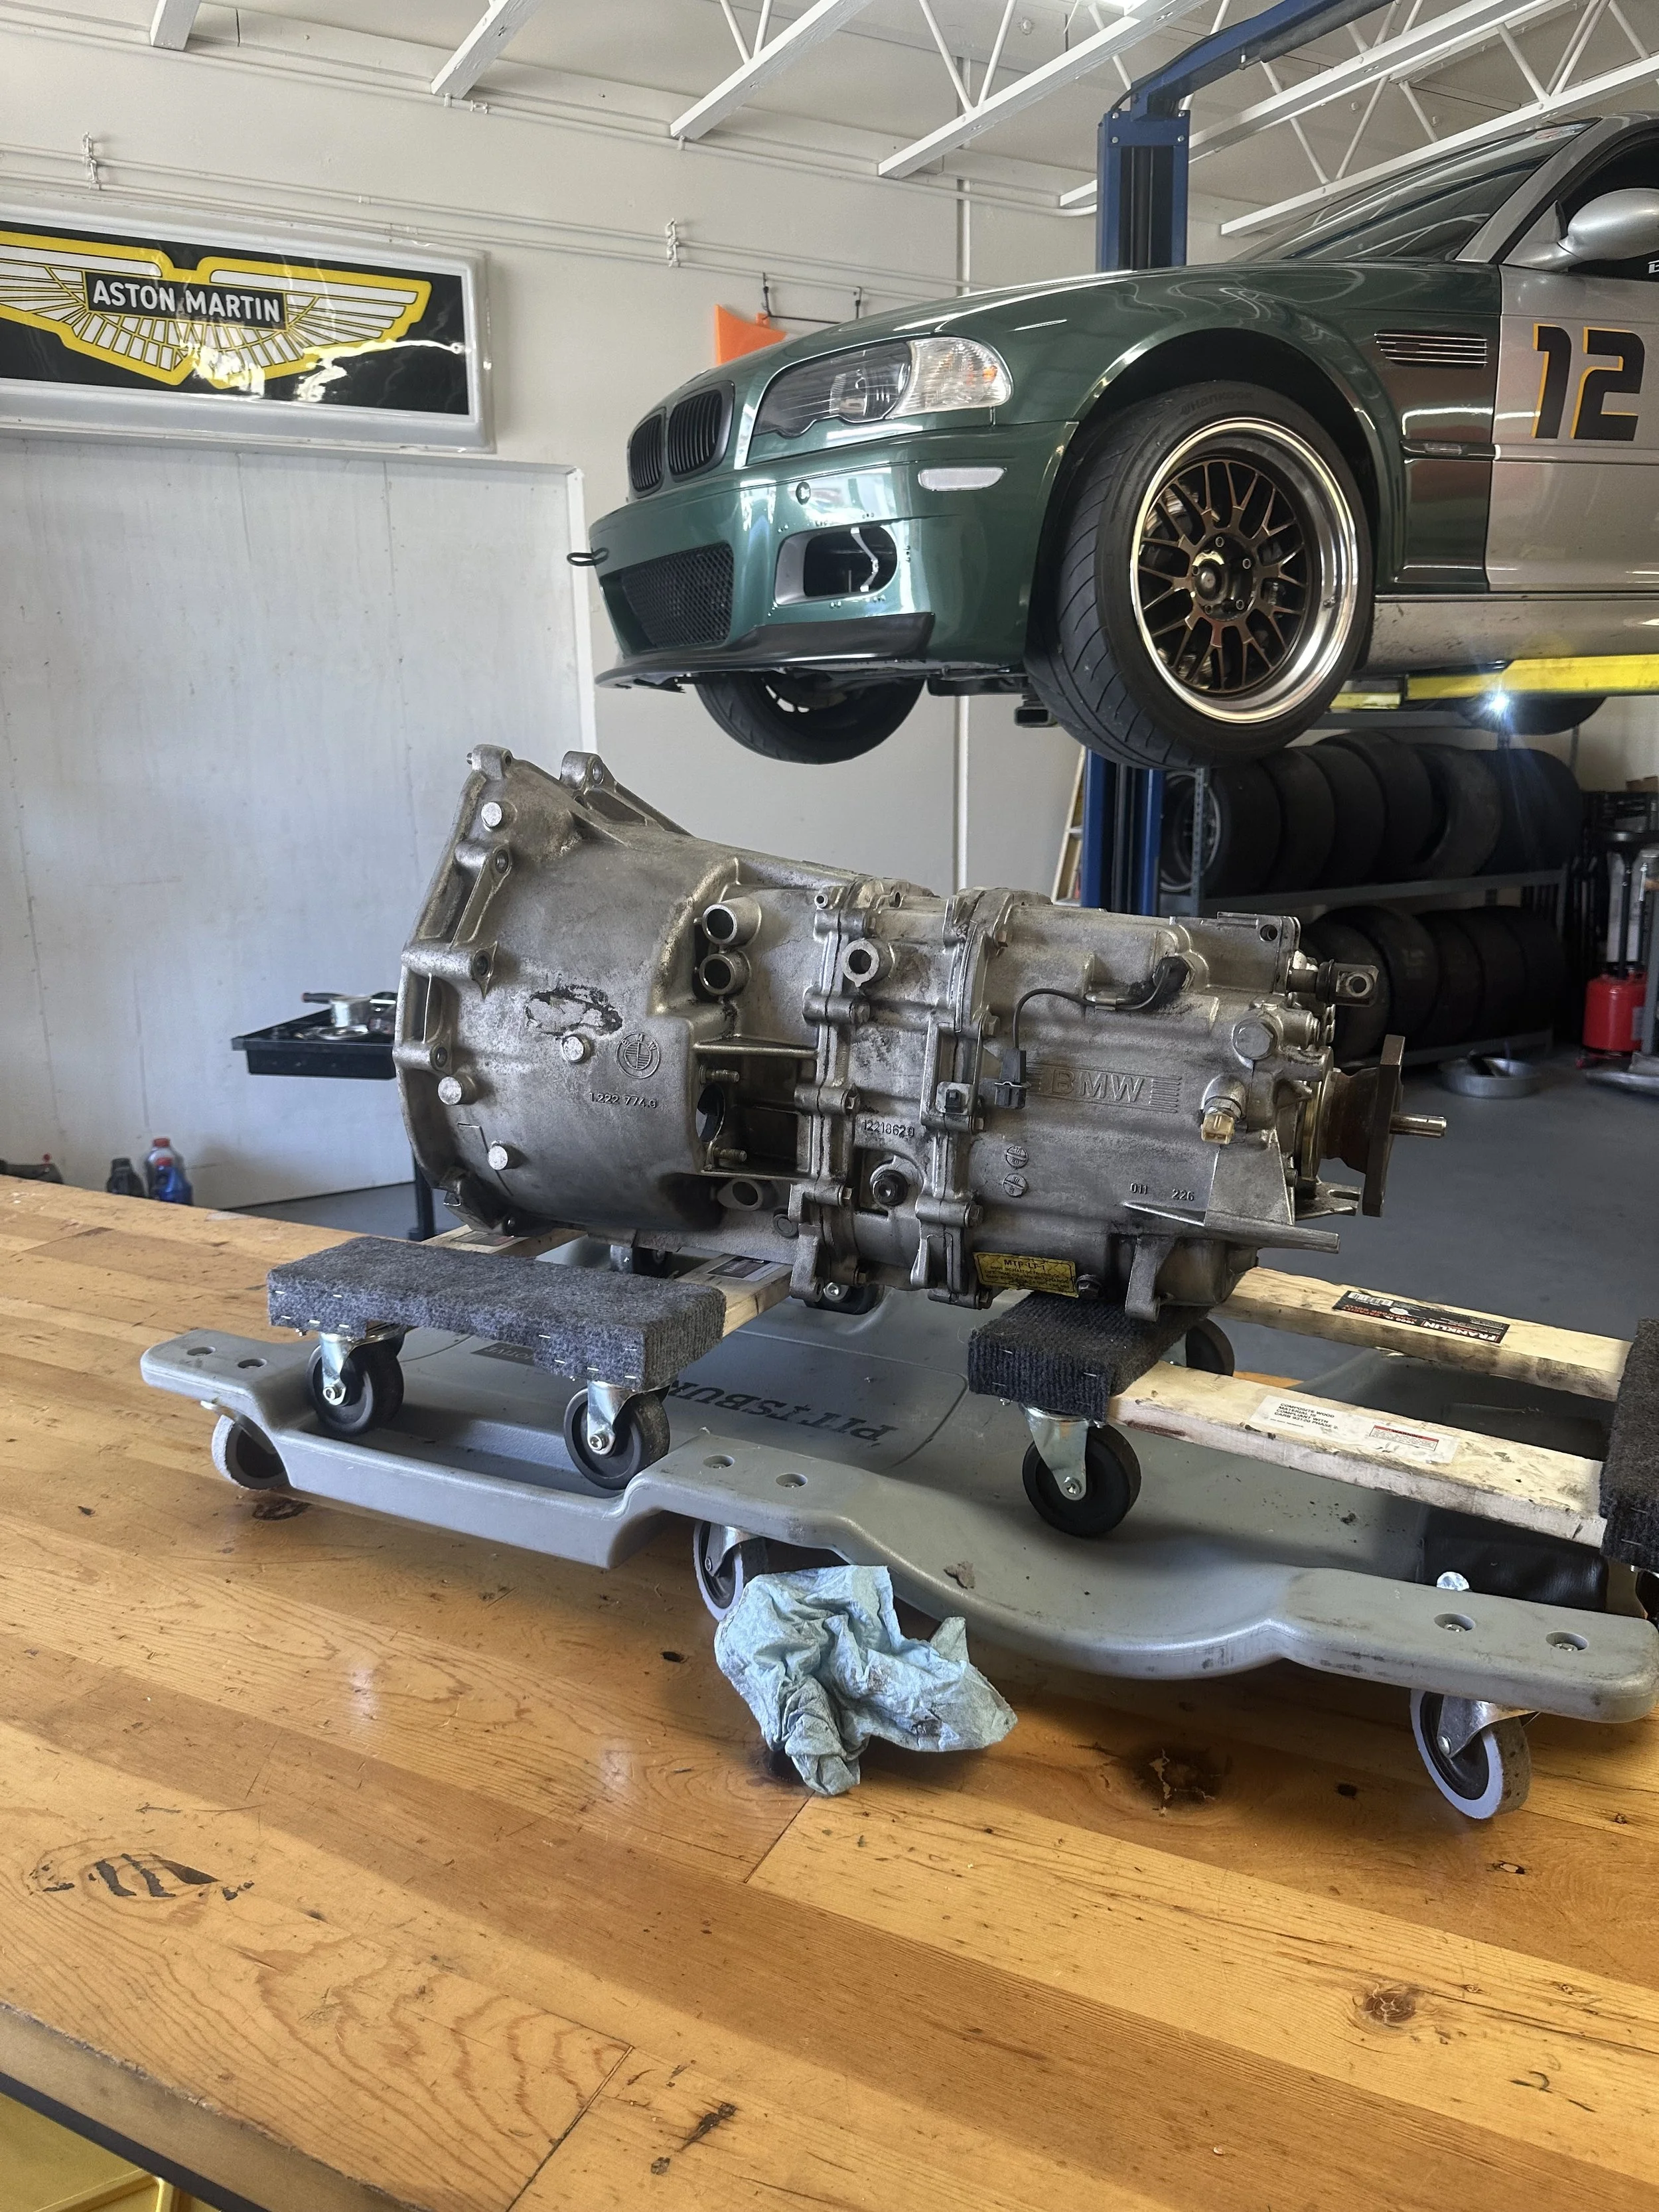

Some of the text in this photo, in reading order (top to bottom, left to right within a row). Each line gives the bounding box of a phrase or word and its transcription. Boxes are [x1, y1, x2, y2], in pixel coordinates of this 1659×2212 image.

[93, 279, 280, 323] ASTON MARTIN
[1531, 323, 1645, 441] 12
[1052, 1069, 1145, 1103] BMW
[1172, 1188, 1194, 1201] 226
[1423, 1321, 1497, 1341] FRANKLIN
[1276, 1409, 1311, 1419] COMPLIANT
[1278, 1406, 1307, 1416] MATERIAL
[1280, 1402, 1315, 1413] COMPOSITE
